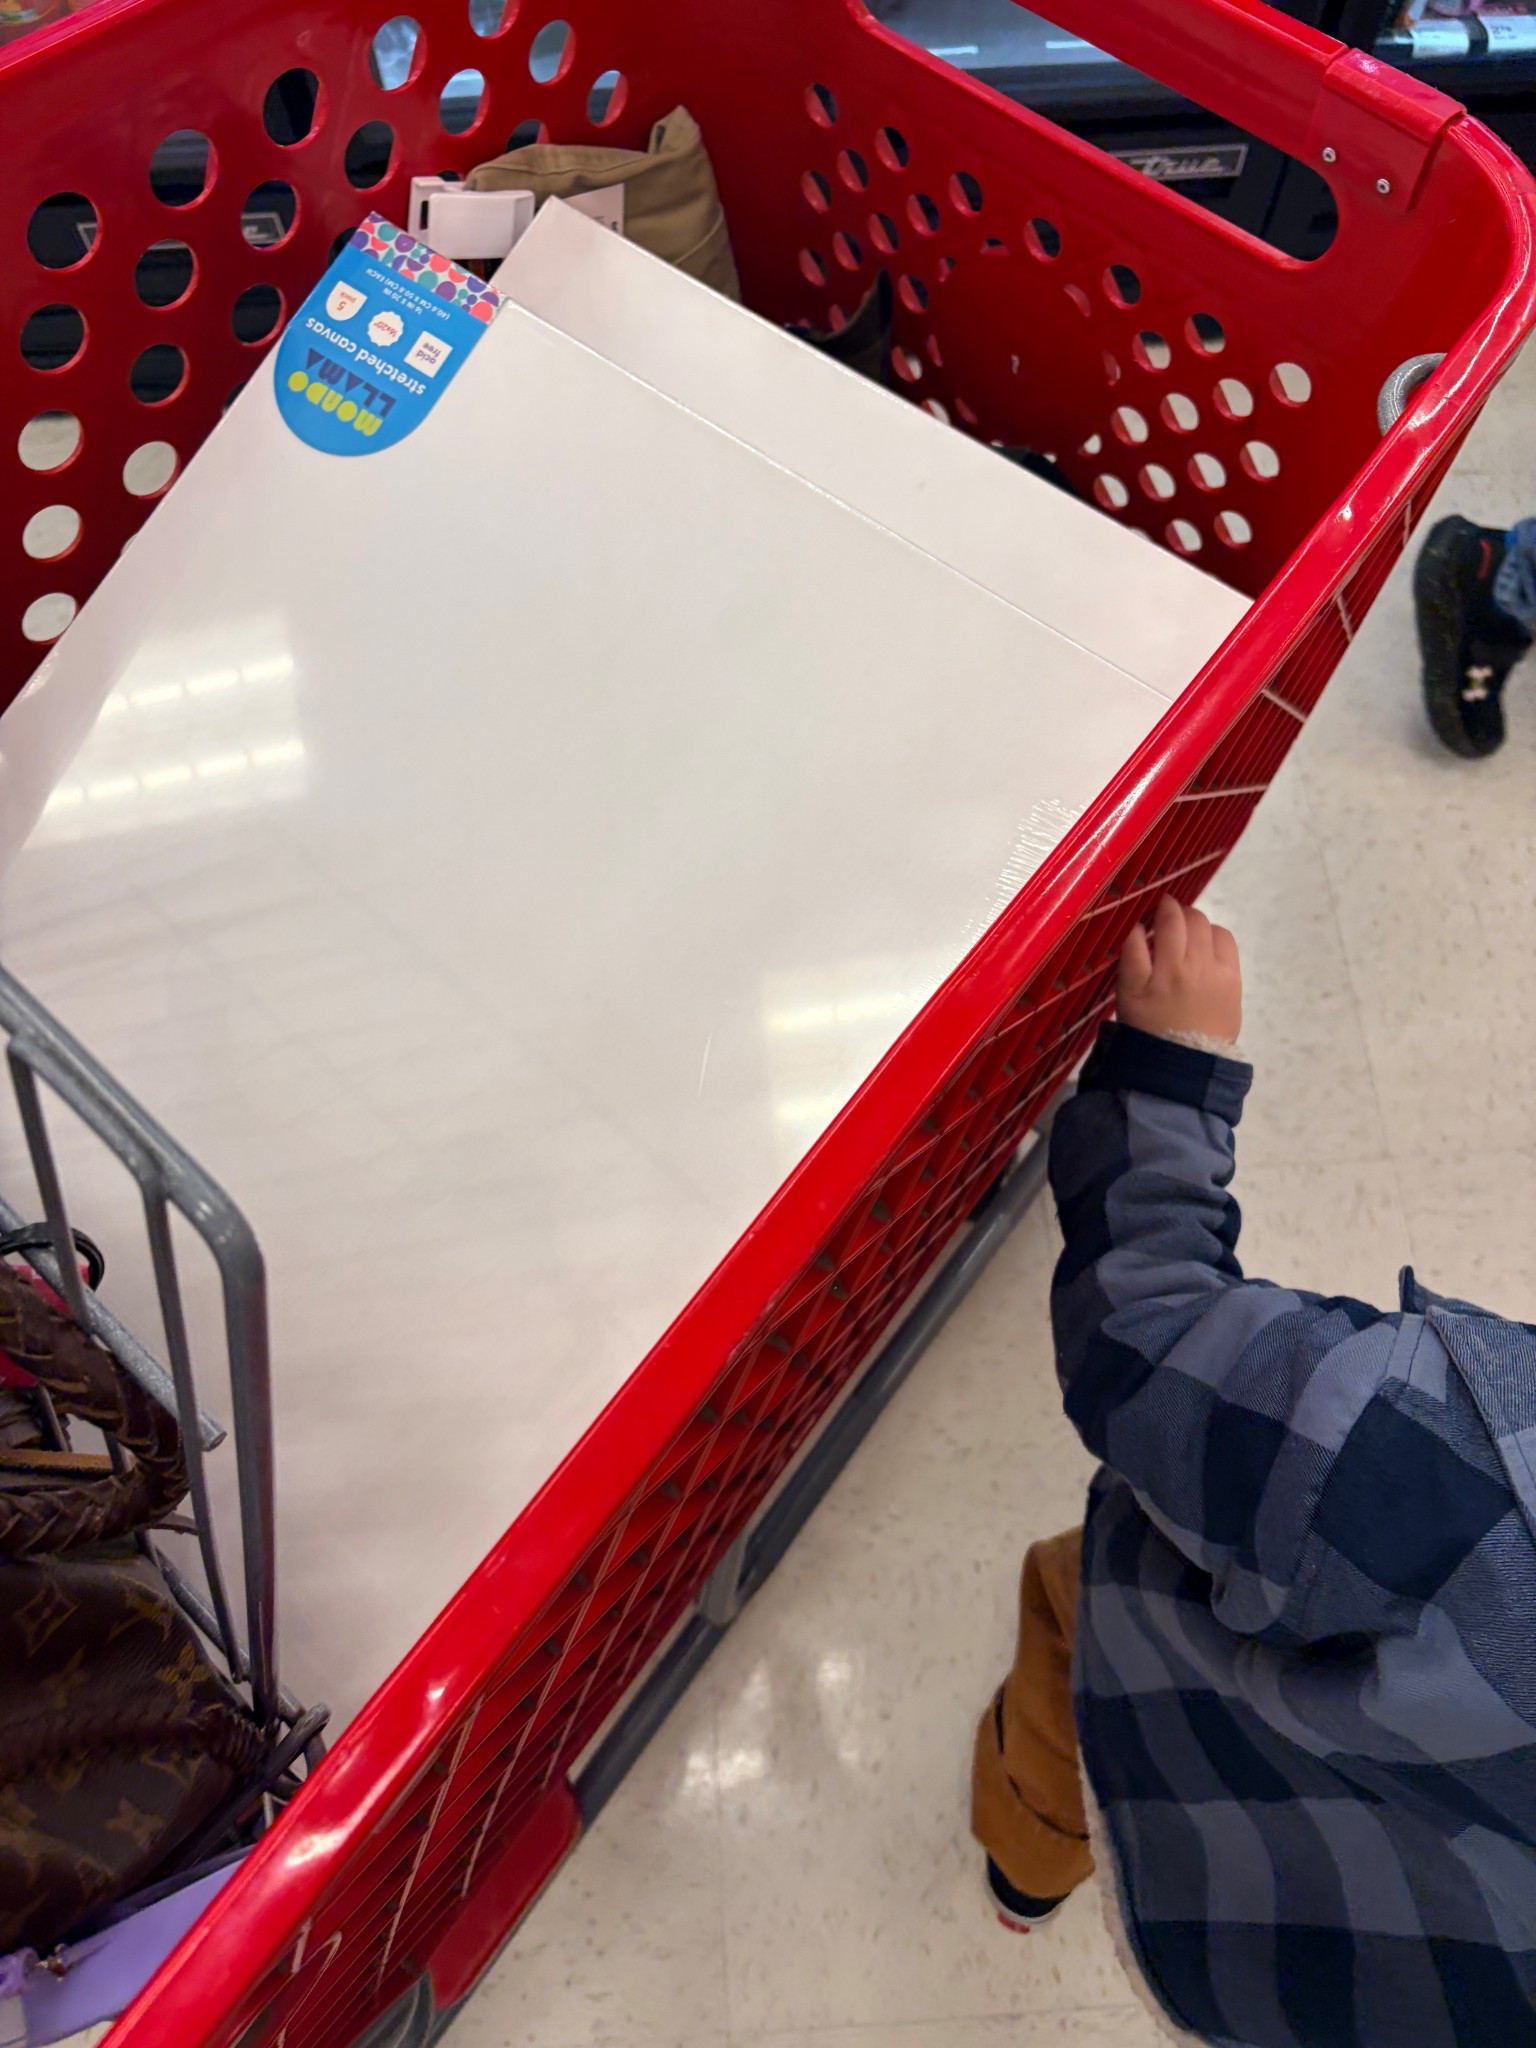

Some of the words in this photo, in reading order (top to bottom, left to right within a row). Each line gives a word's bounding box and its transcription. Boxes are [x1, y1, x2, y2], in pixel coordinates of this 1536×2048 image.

[365, 268, 386, 282] EACH
[339, 290, 358, 304] pack
[383, 287, 393, 296] IN
[390, 291, 402, 302] 20
[336, 300, 345, 312] 5
[405, 301, 416, 310] IN
[414, 305, 423, 315] 16
[419, 298, 432, 309] CM
[305, 317, 357, 354] canvas
[414, 349, 437, 366] acid
[422, 342, 442, 359] free
[354, 345, 427, 396] stretched
[305, 347, 397, 418] LLAMA
[287, 370, 384, 437] MONDO
